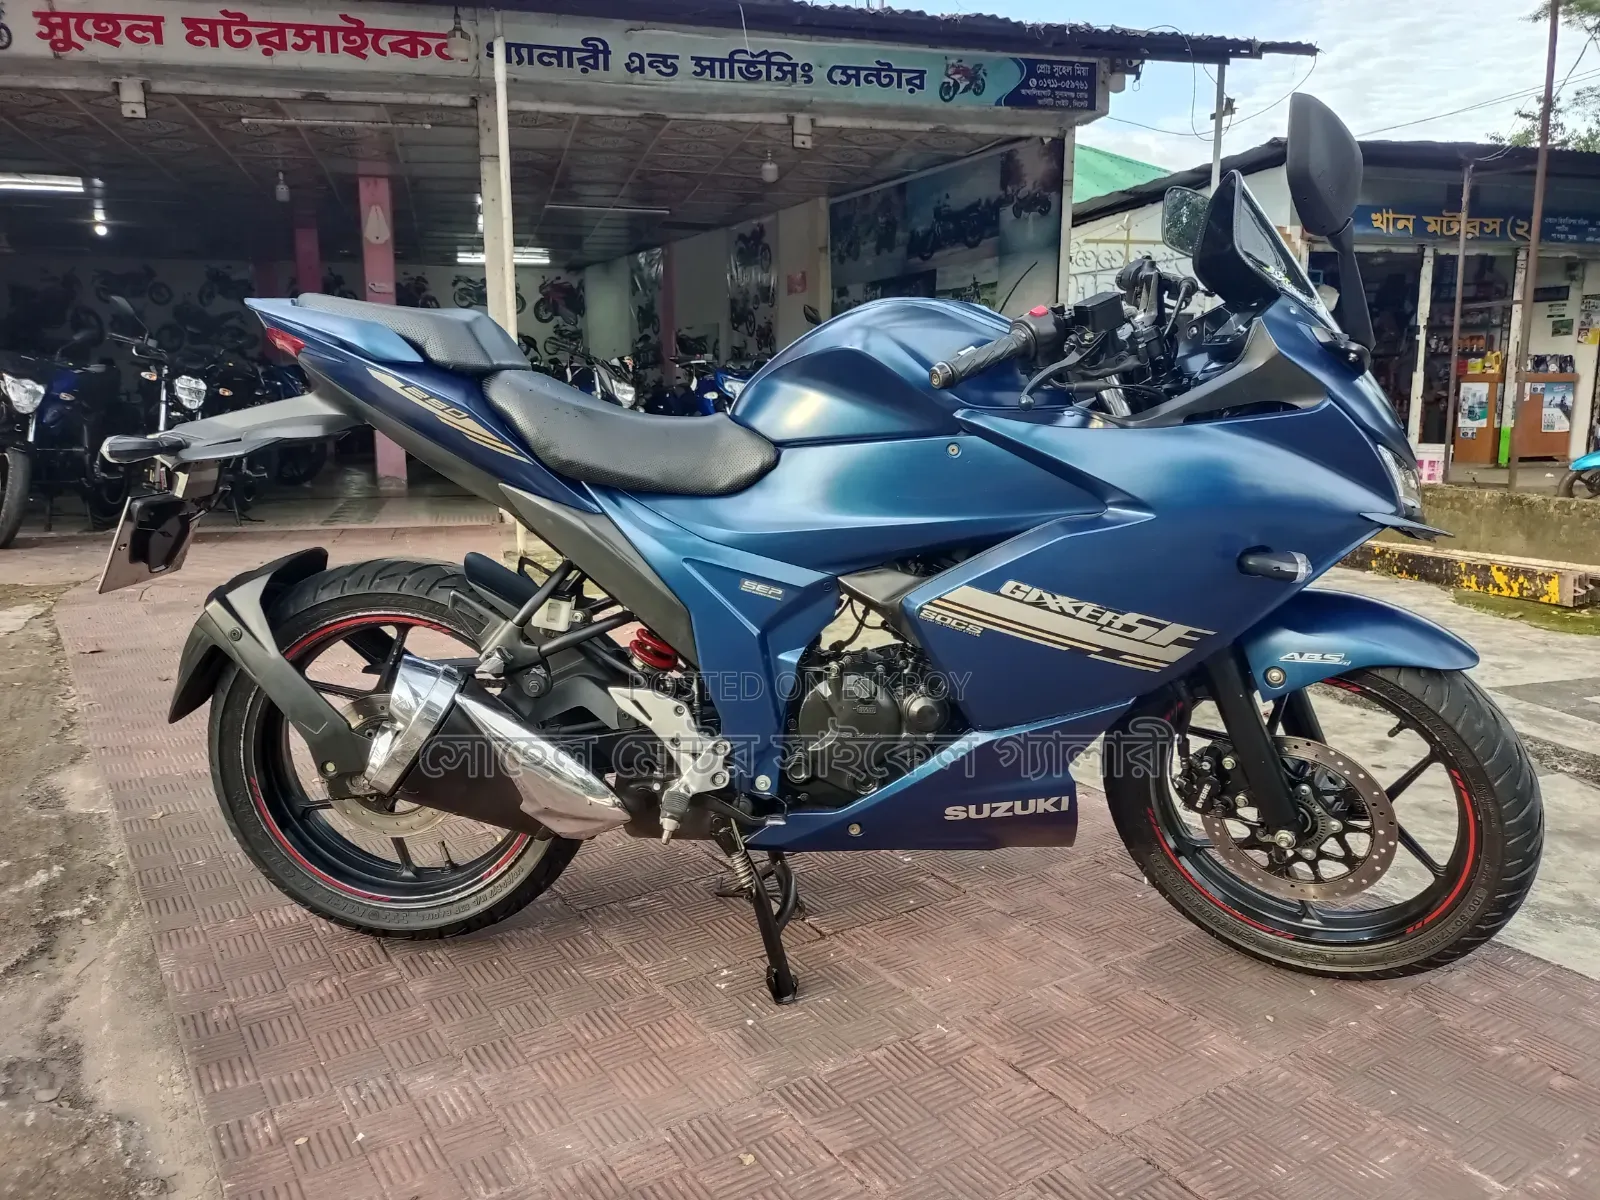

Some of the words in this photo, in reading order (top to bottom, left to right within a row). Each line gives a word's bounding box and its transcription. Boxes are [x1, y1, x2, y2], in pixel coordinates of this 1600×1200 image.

[33, 11, 164, 52] সুহেল
[624, 52, 679, 77] এন্ড
[826, 60, 927, 94] সেন্টার
[1370, 208, 1416, 235] খান
[742, 580, 783, 596] SEP
[999, 580, 1122, 629] GIXXER
[919, 609, 984, 634] SOCS
[1279, 652, 1345, 663] ABS
[944, 795, 1070, 821] SUZUKI
[1195, 783, 1212, 809] BYBRE
